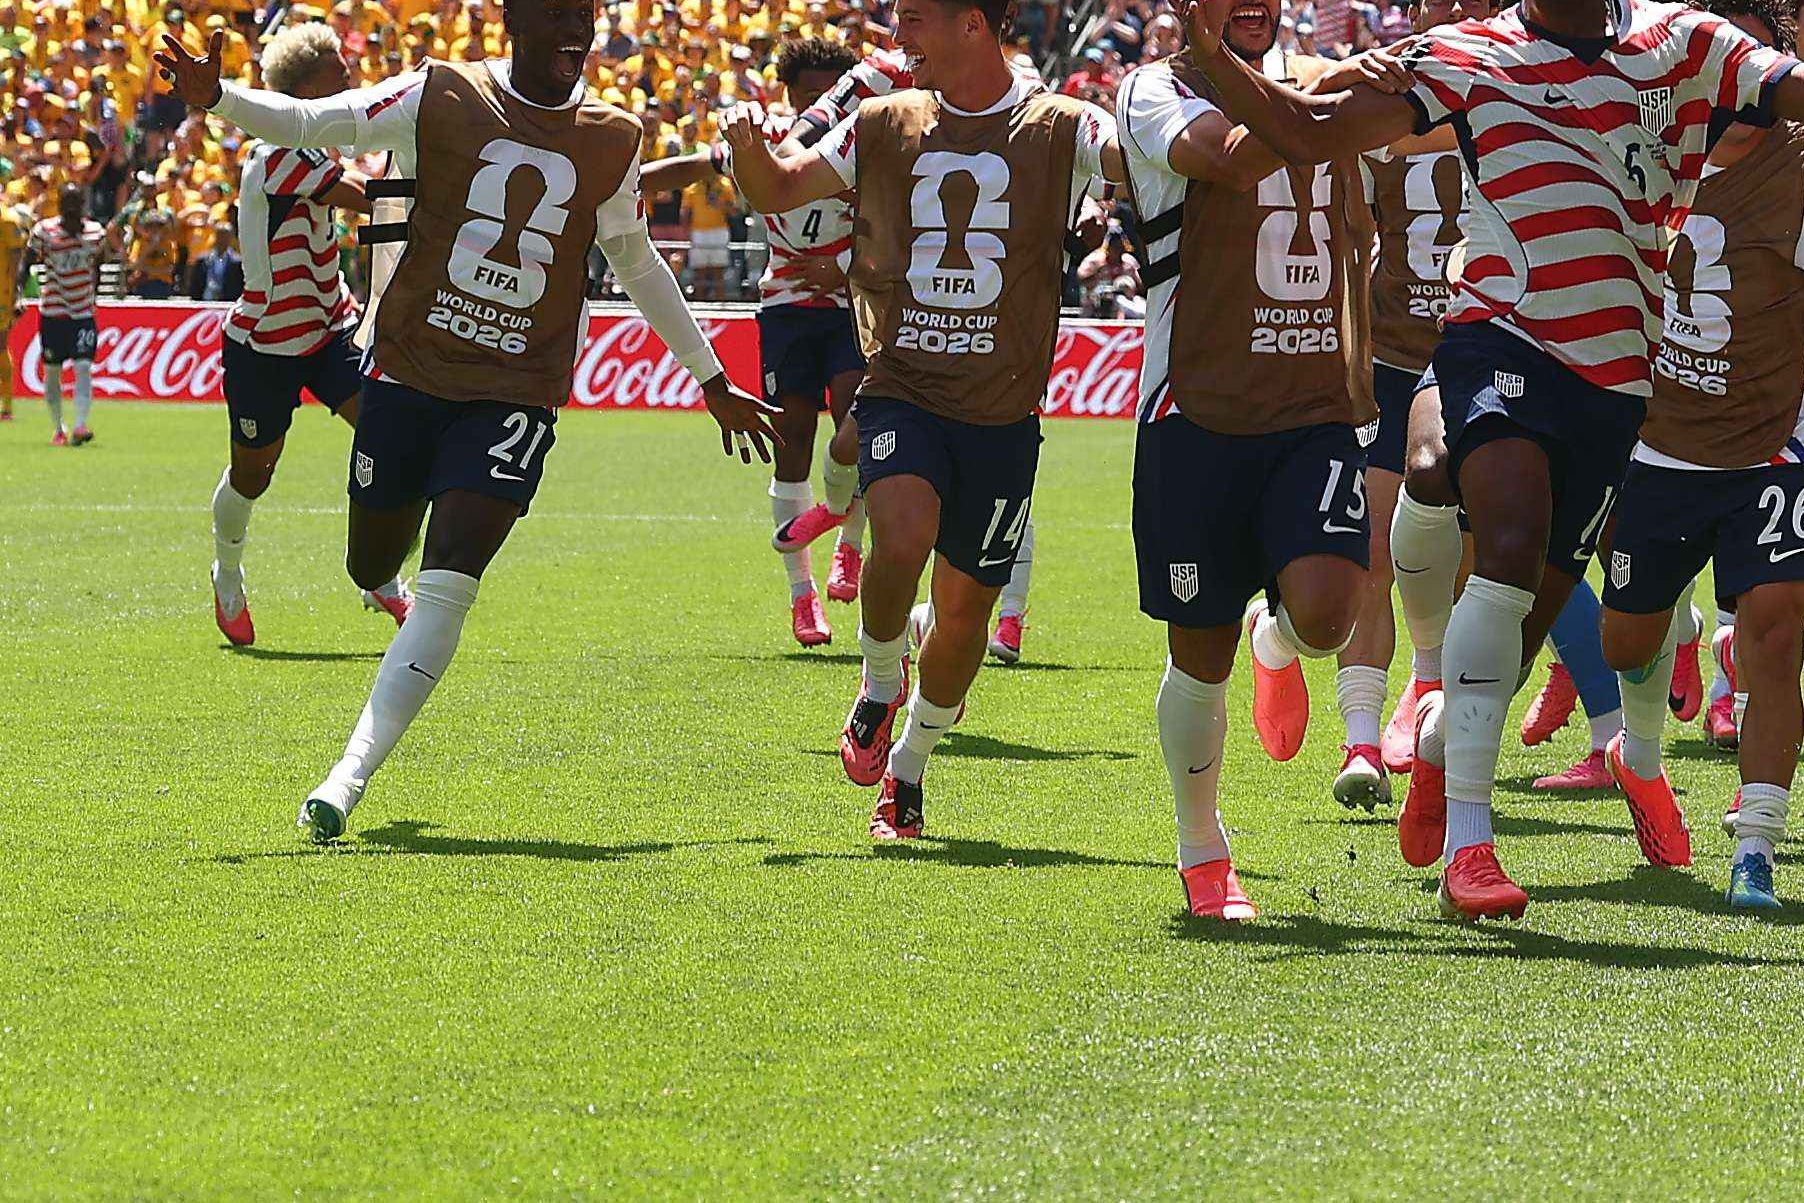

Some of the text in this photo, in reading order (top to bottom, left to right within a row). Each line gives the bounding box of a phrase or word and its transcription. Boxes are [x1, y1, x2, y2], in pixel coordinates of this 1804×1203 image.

[1640, 88, 1669, 110] USA
[801, 209, 822, 244] 4
[473, 266, 518, 293] FIFA
[932, 277, 976, 294] FIFA
[1286, 265, 1320, 284] FIFA
[436, 289, 533, 330] WORLD CUP
[902, 308, 998, 329] WORLD CUP
[1253, 307, 1334, 325] WORLD CUP
[1409, 298, 1450, 317] 20
[426, 306, 528, 354] 2026
[895, 326, 995, 354] 2026
[1251, 327, 1339, 354] 2026
[1658, 342, 1731, 374] ORLD CUP
[1655, 356, 1727, 396] 026
[488, 412, 547, 470] 21
[1319, 459, 1365, 520] 15
[982, 498, 1029, 551] 14
[1171, 564, 1197, 580] USA
